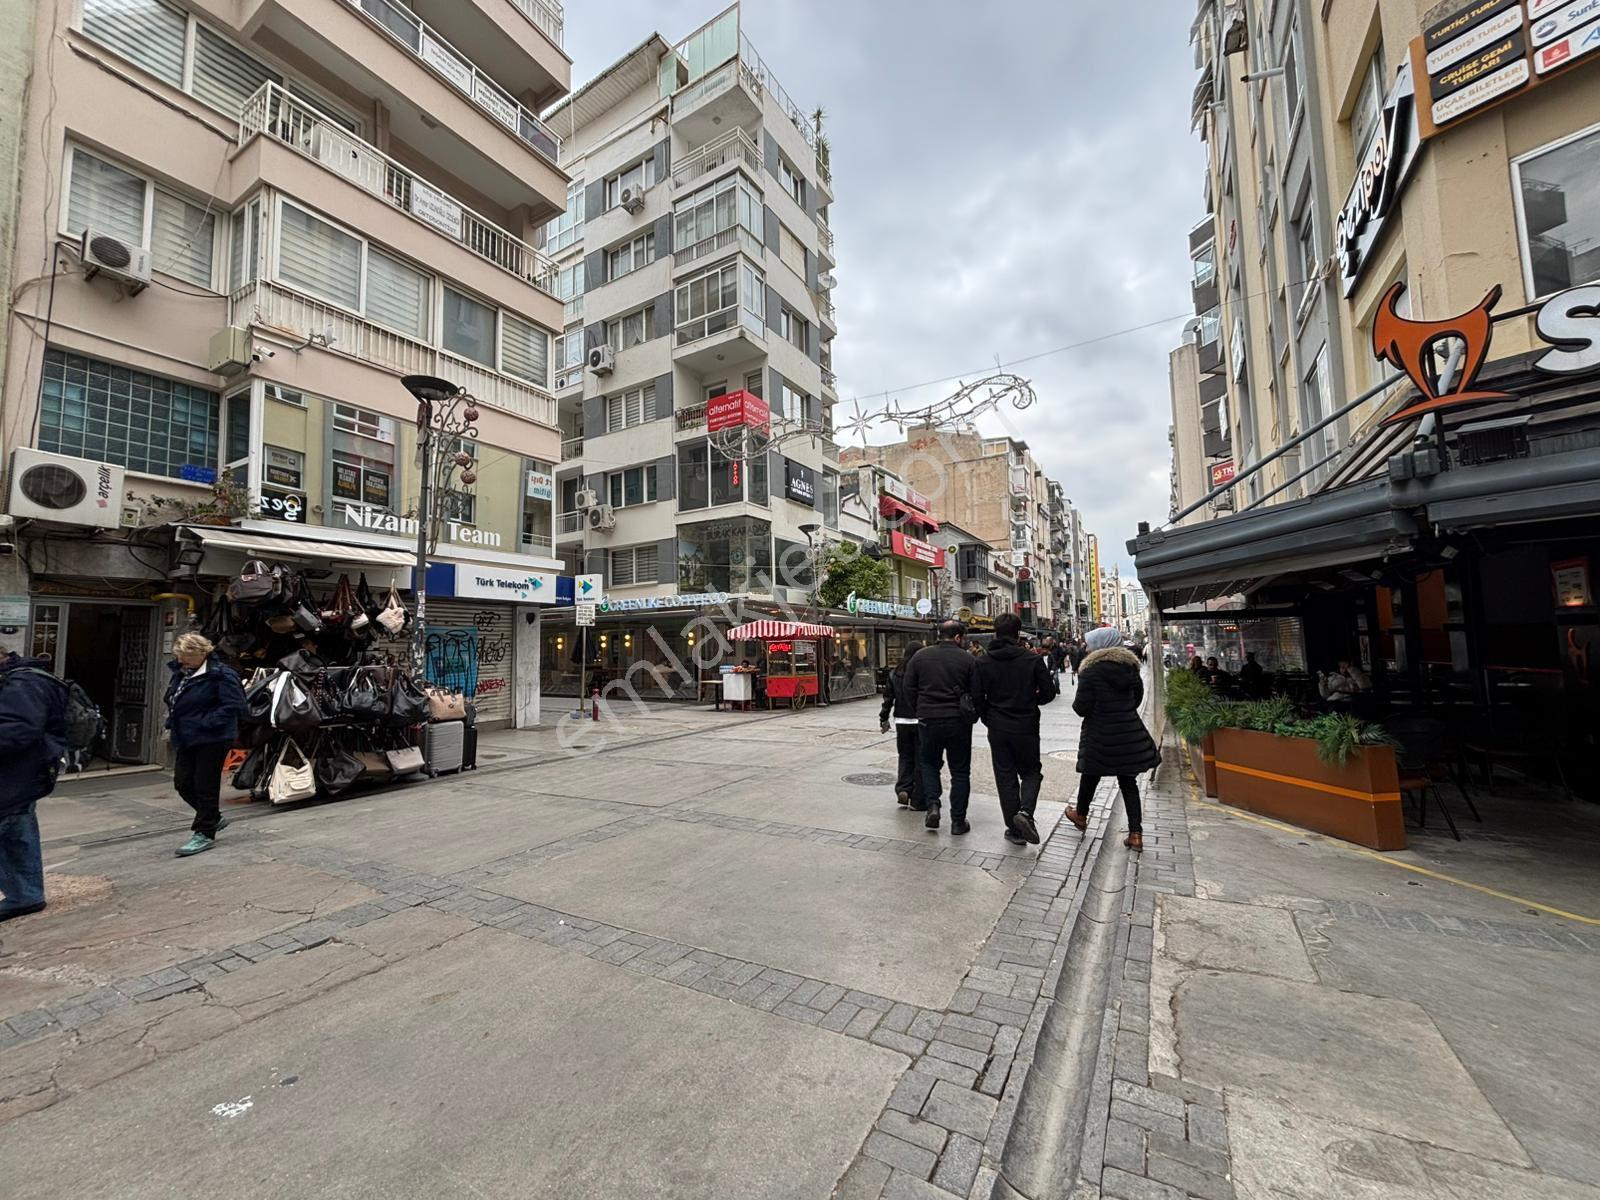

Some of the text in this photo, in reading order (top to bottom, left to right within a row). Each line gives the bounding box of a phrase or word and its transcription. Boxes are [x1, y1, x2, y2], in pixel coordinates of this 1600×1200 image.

[1478, 13, 1518, 41] TURLAR
[1481, 40, 1513, 60] GEMİ
[1451, 57, 1501, 87] TURLARI
[1435, 64, 1523, 113] UÇAK BİLETLERİ
[1334, 107, 1390, 280] gezipol
[708, 400, 742, 416] alternatif
[97, 463, 112, 499] arçelik
[790, 477, 814, 494] AGNES
[345, 504, 501, 546] Nizam Team
[475, 577, 529, 590] Türk Telekom
